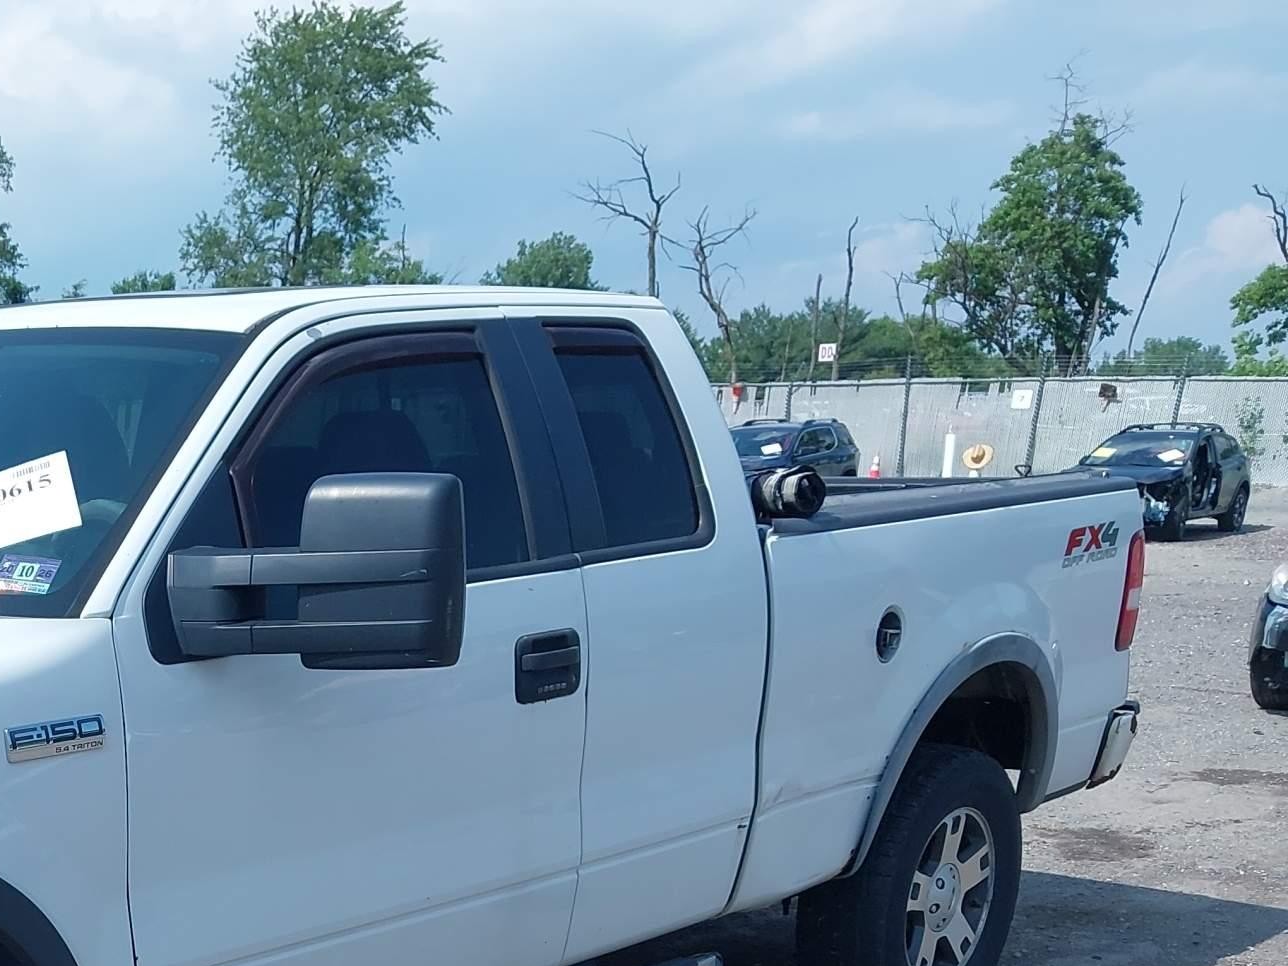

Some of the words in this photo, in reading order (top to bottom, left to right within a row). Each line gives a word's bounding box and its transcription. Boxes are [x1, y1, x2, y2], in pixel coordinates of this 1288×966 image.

[1064, 520, 1120, 557] FX4
[17, 564, 35, 578] 10
[9, 716, 105, 750] F-150
[72, 739, 104, 751] TRITON
